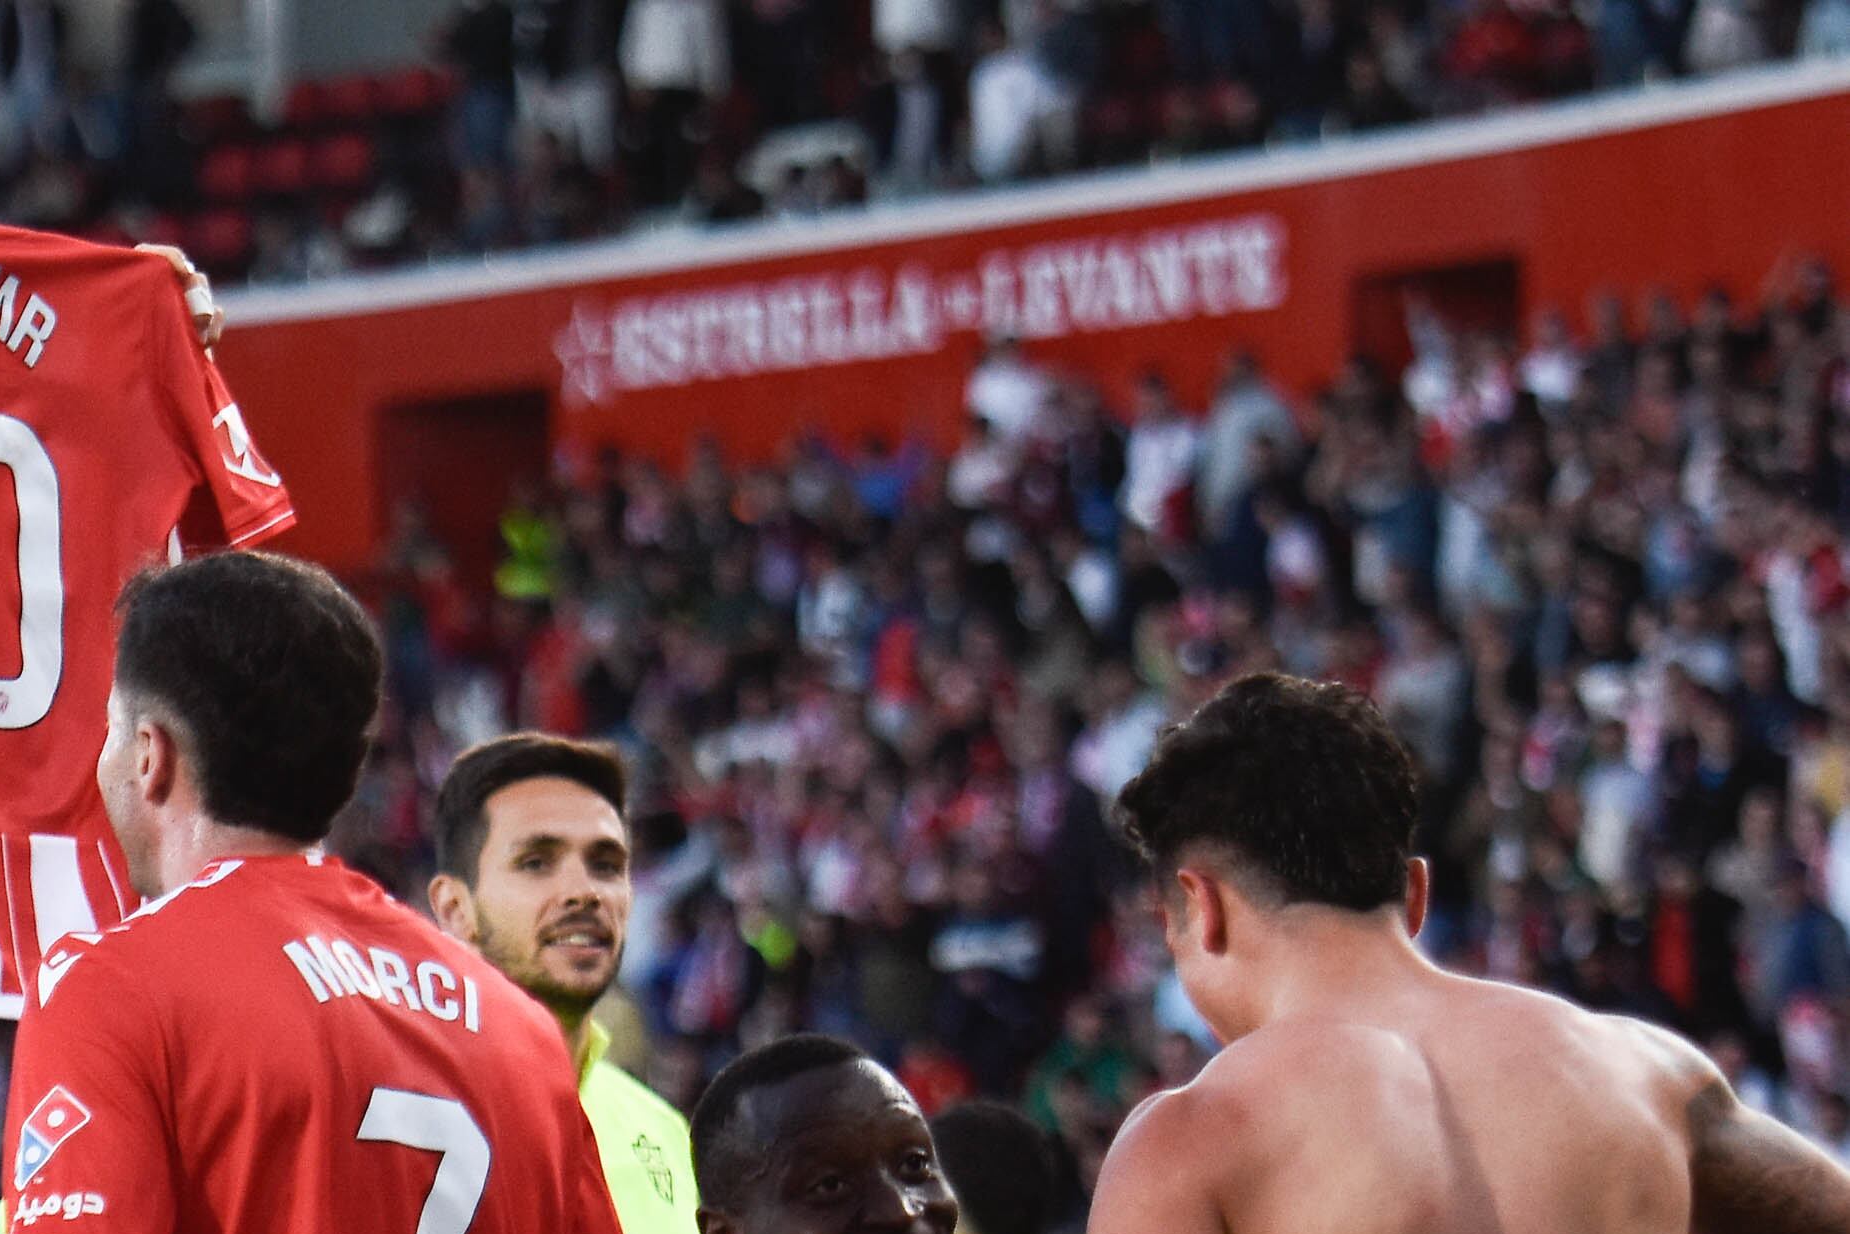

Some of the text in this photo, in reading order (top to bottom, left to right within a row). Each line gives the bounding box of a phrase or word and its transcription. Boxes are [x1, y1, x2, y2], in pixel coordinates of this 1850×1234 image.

[611, 215, 1288, 389] ESTRELLA LEVANTE
[282, 936, 481, 1033] MORCI
